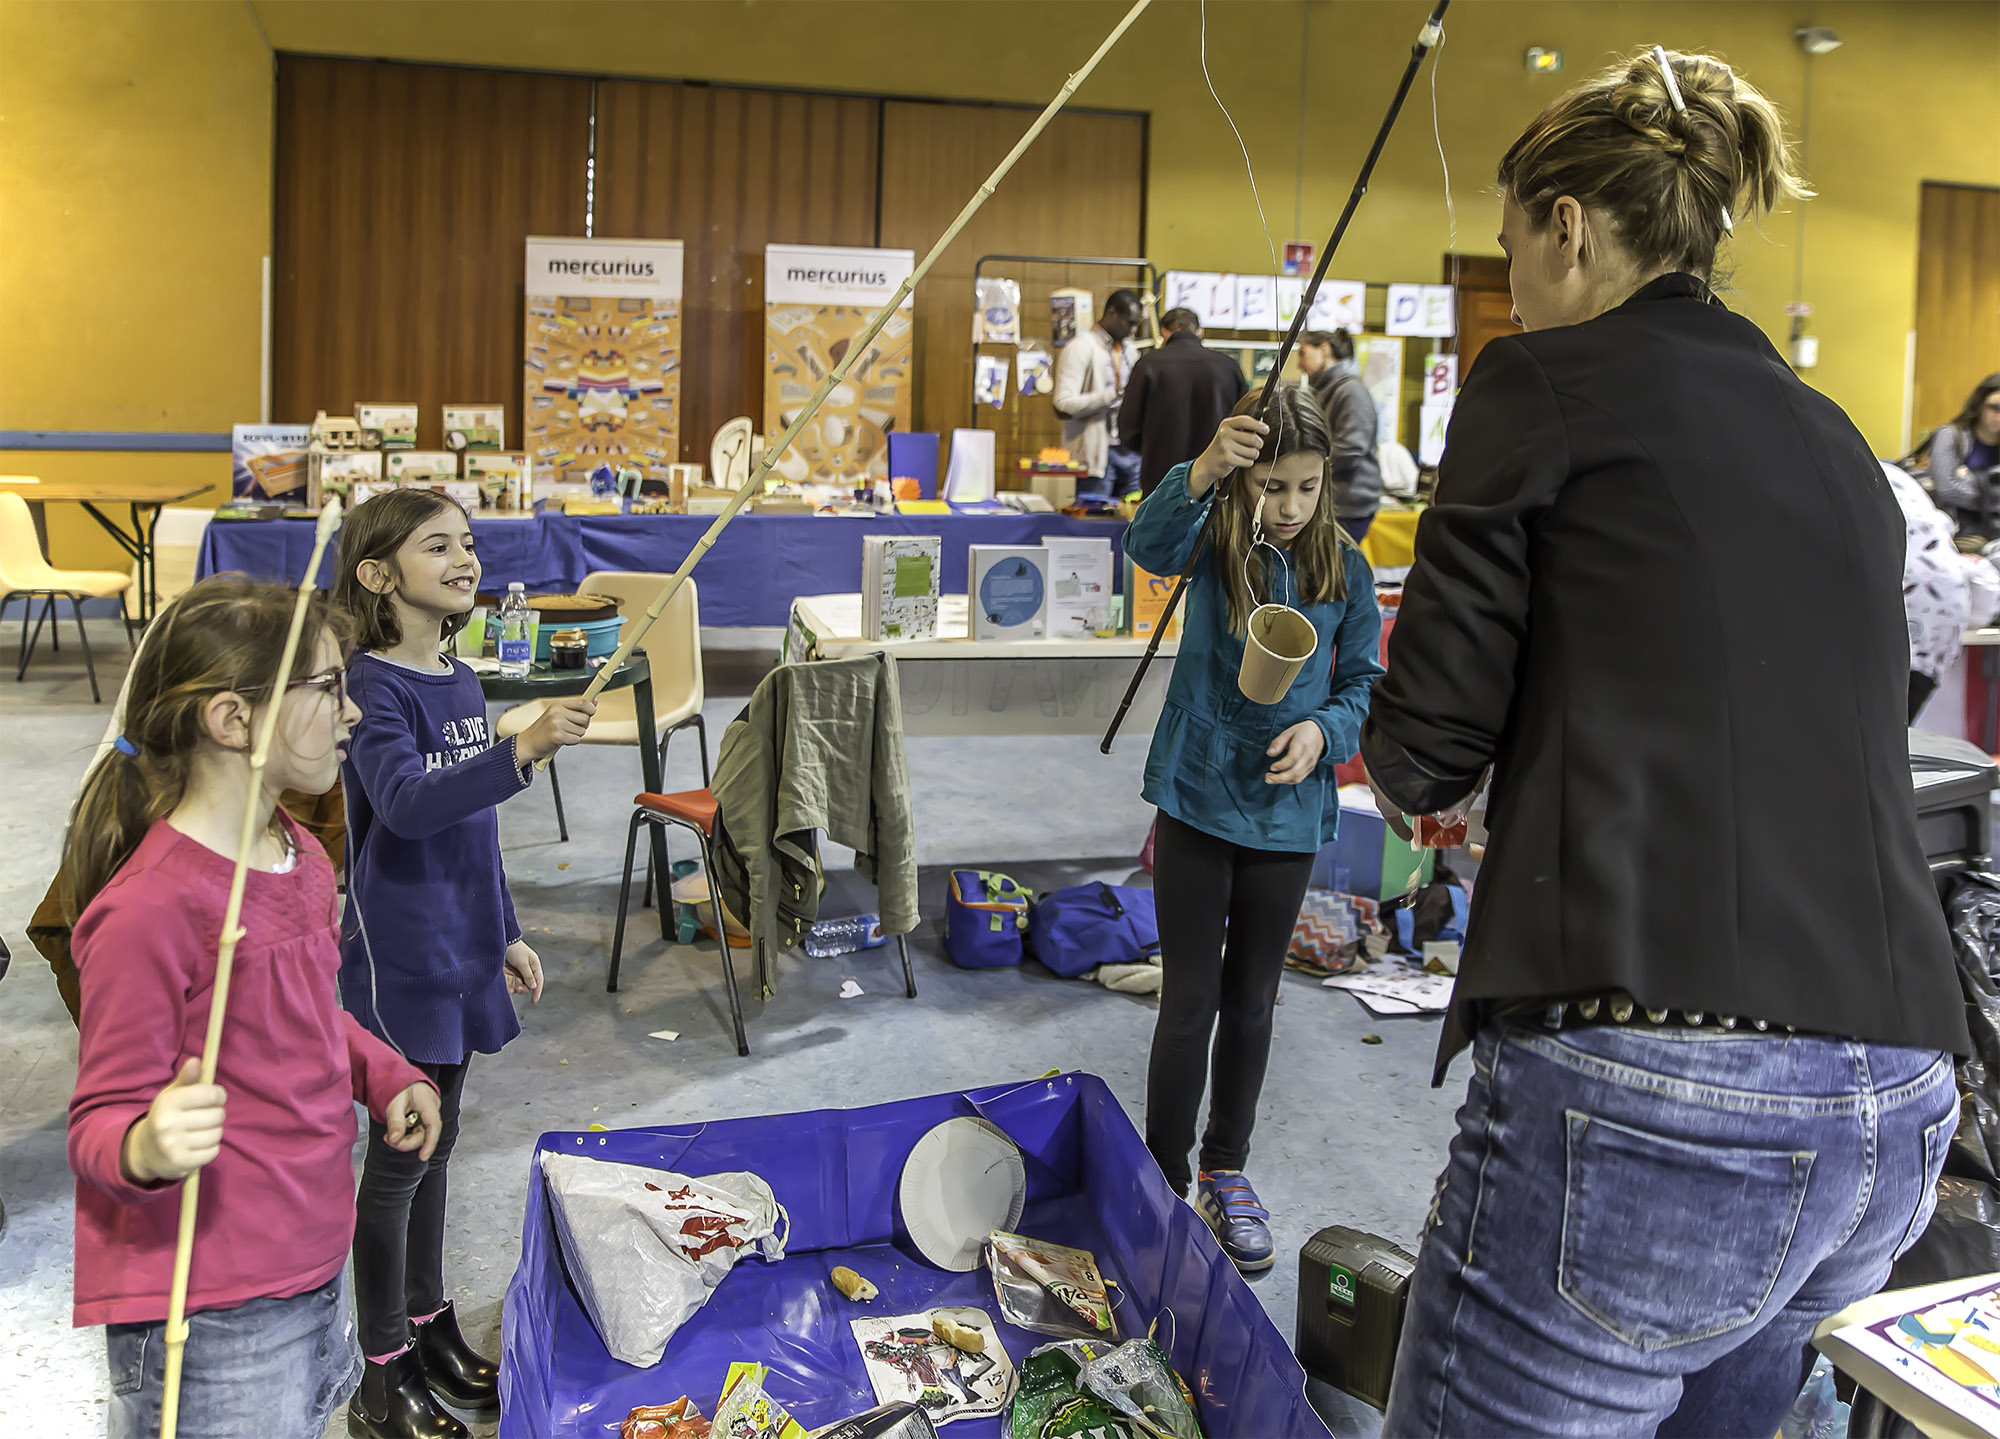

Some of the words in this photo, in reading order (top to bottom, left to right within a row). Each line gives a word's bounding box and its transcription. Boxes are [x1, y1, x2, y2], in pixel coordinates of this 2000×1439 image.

[548, 256, 655, 277] mercurius
[787, 266, 887, 286] mercurius
[1394, 295, 1449, 328] DE
